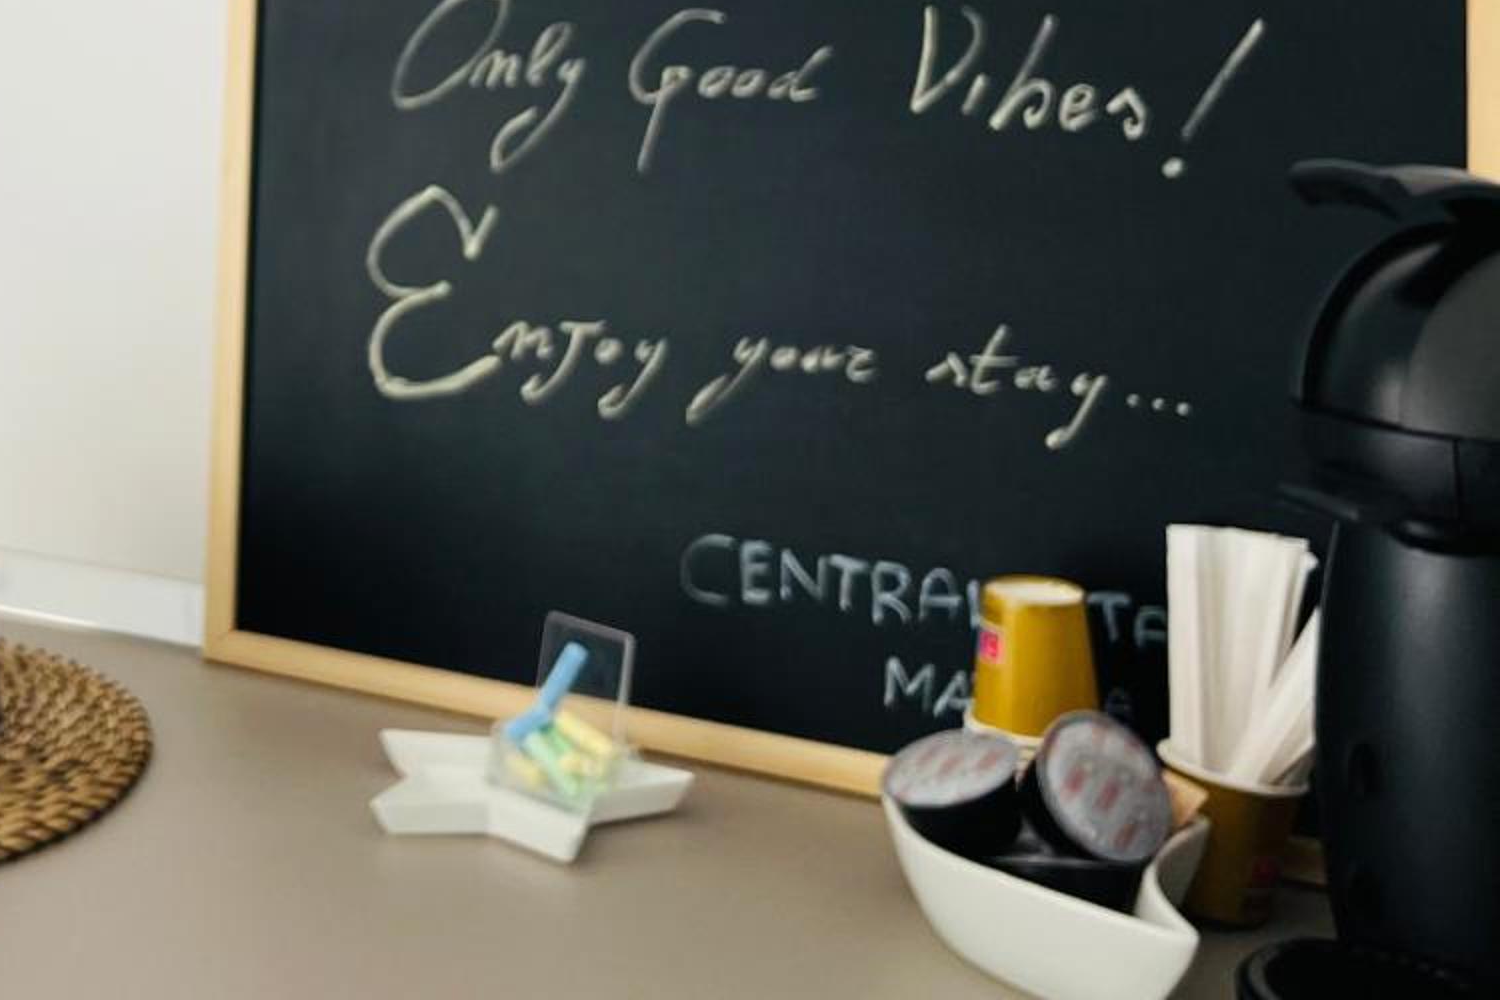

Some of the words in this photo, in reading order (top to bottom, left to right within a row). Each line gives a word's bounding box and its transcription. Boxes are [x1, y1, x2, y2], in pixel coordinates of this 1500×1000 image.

[628, 8, 834, 173] Good
[910, 5, 1267, 179] Vibes!
[685, 336, 879, 425] your
